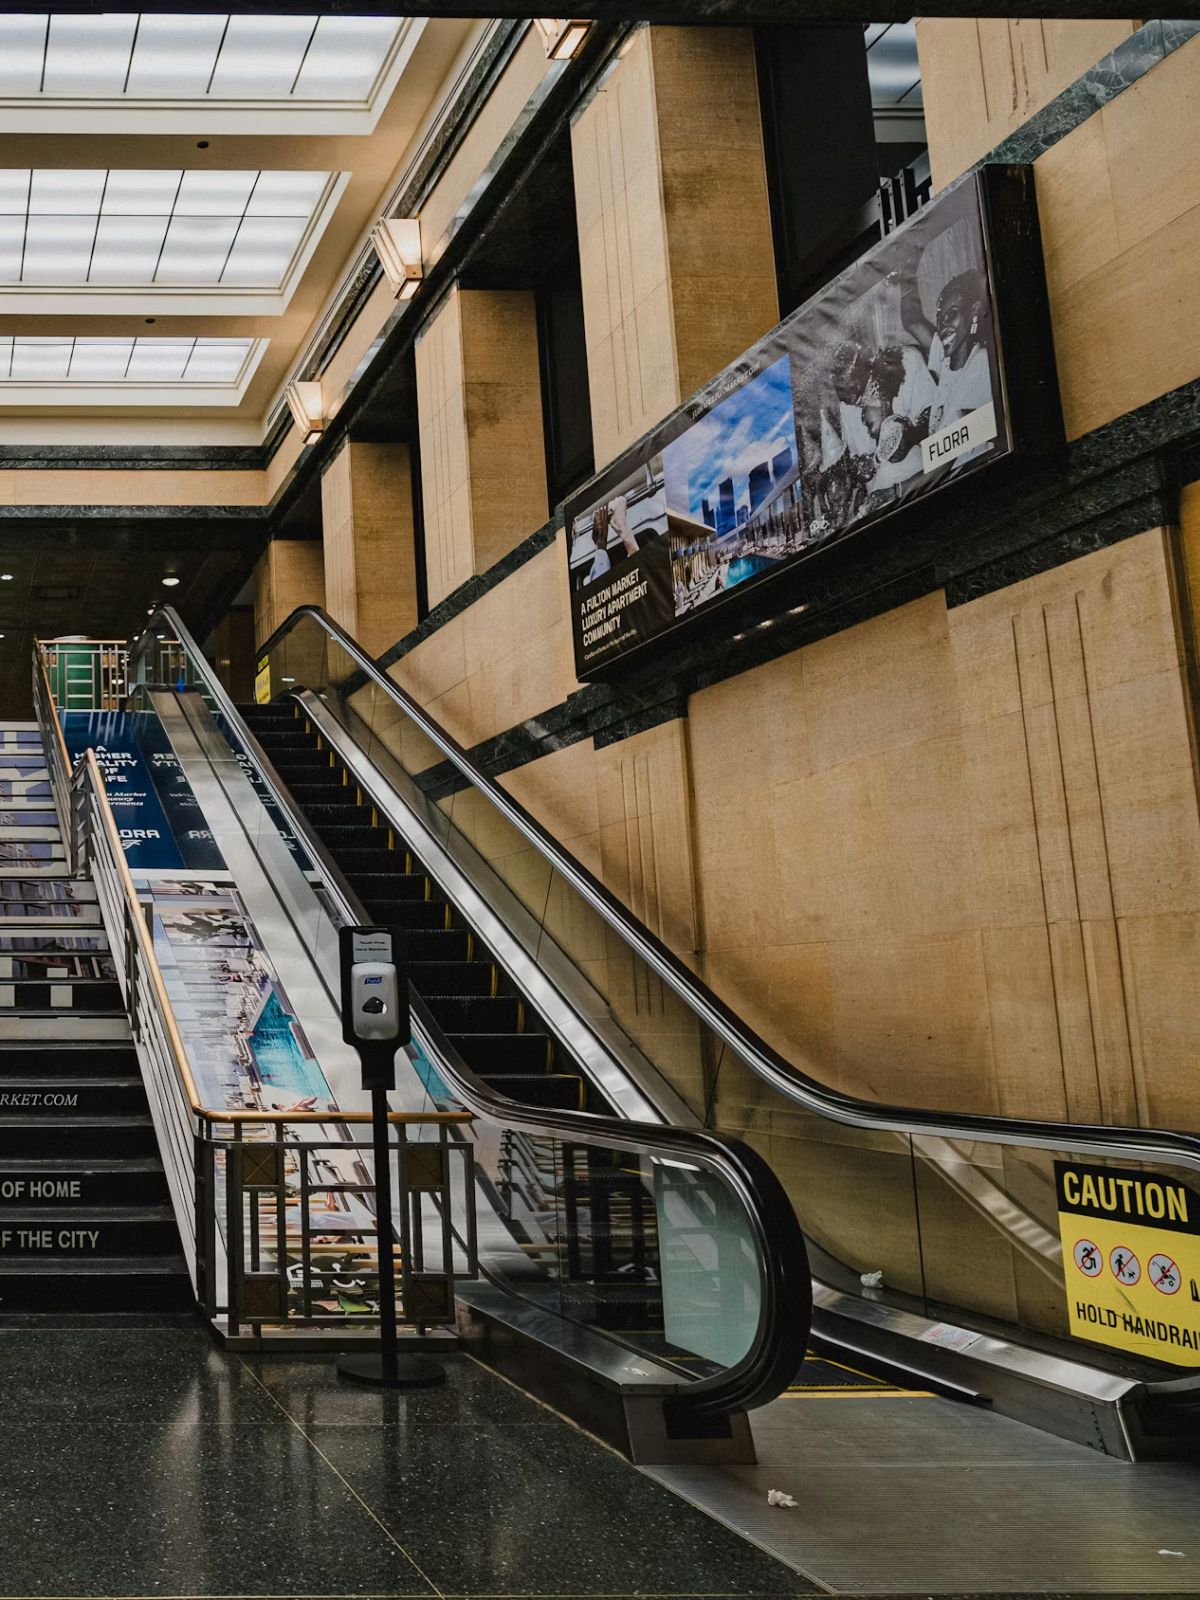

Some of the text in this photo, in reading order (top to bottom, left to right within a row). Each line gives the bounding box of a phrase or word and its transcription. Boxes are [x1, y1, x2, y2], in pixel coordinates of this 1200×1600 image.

[929, 425, 970, 462] FLORA
[581, 567, 639, 616] A FULTON MARKET
[582, 581, 648, 631] LUXURY APARTMENT
[583, 614, 621, 647] COMMUNITY
[118, 829, 161, 839] ORA
[1, 1181, 25, 1198] OF
[30, 1180, 81, 1198] HOME
[1063, 1171, 1189, 1223] CAUTION
[17, 1231, 52, 1248] THE
[58, 1231, 99, 1248] CITY
[1076, 1301, 1200, 1352] HOLD HANDRAI
